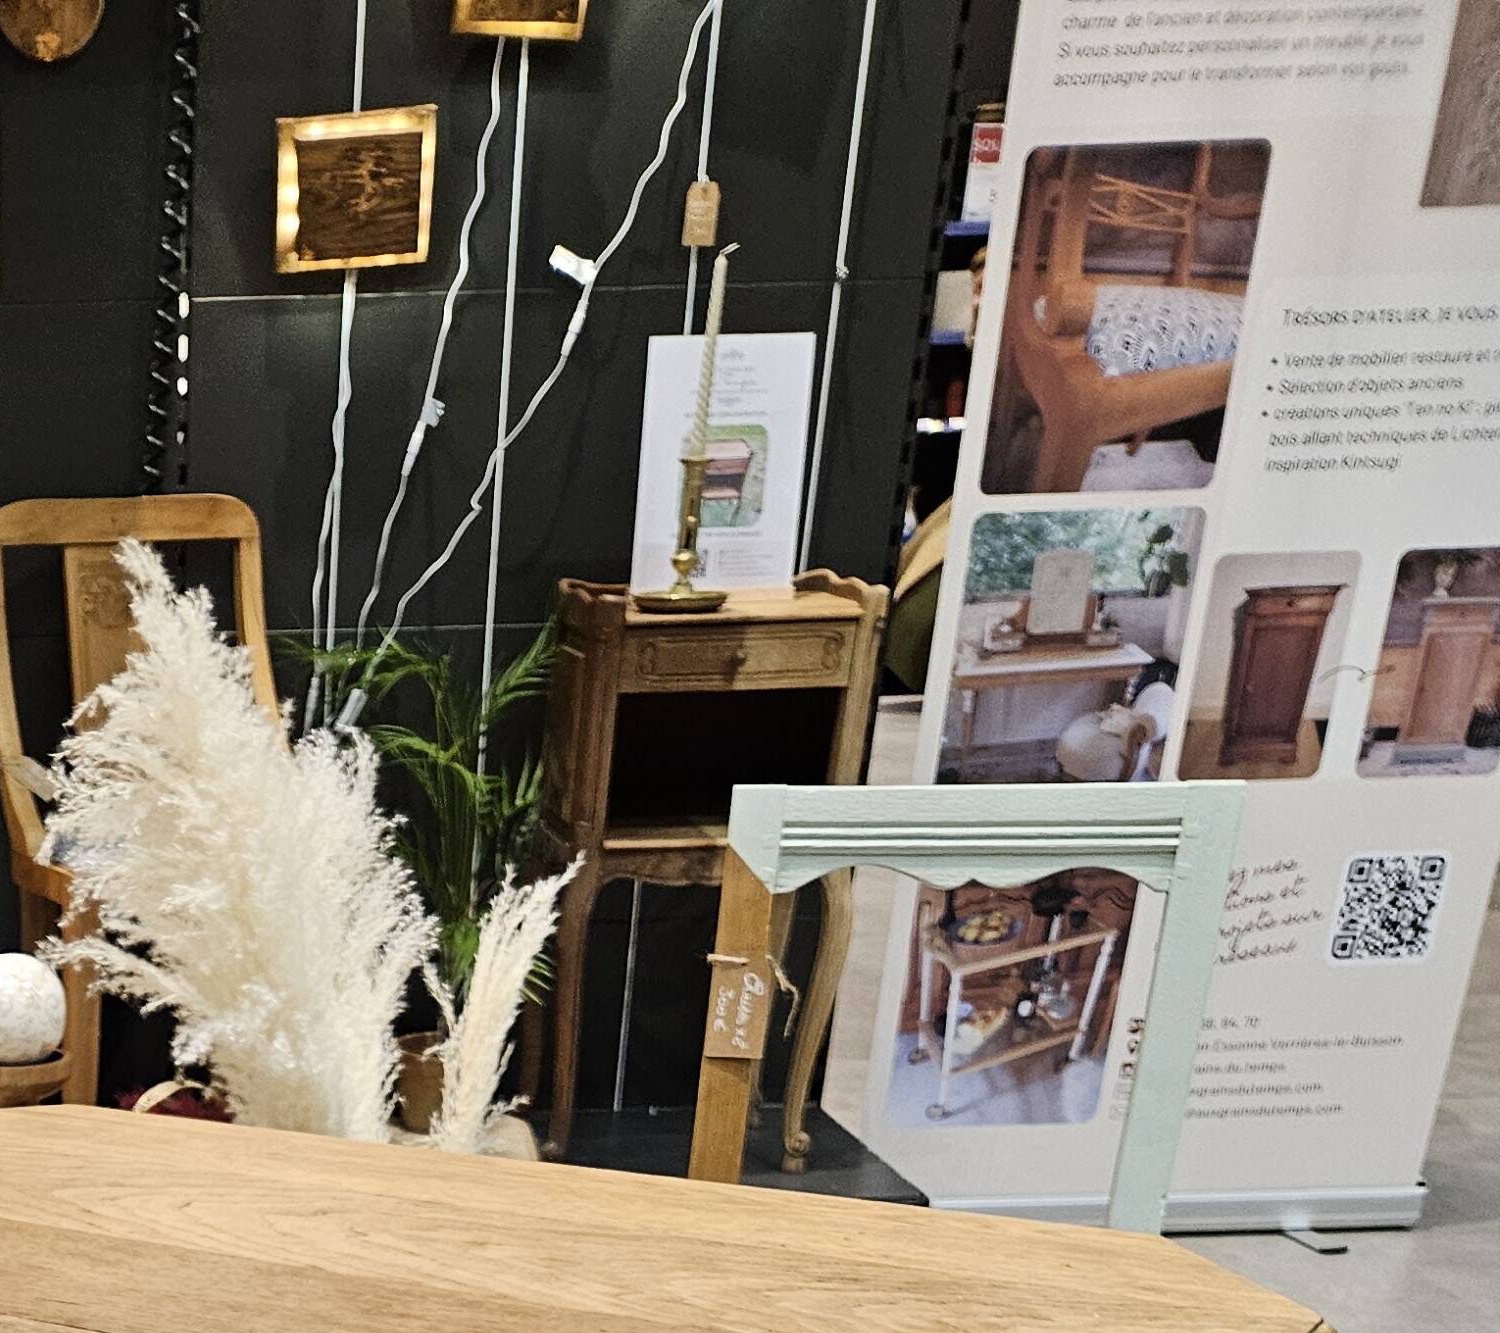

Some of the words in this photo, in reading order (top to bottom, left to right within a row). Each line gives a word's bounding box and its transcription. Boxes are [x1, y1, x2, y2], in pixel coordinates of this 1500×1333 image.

[1124, 12, 1142, 28] de
[1075, 43, 1109, 58] vous
[1114, 40, 1184, 57] souhaitez
[1053, 69, 1149, 88] accompagne
[1151, 68, 1186, 86] pour
[1457, 304, 1498, 322] VOUS
[1284, 352, 1326, 368] Vente
[1328, 352, 1345, 367] de
[1348, 350, 1408, 366] mobilier
[1475, 348, 1490, 362] et
[1407, 376, 1465, 391] anciens
[1343, 403, 1400, 420] uniques
[1269, 430, 1297, 446] bois
[1346, 427, 1428, 445] techniques
[1430, 426, 1449, 442] de
